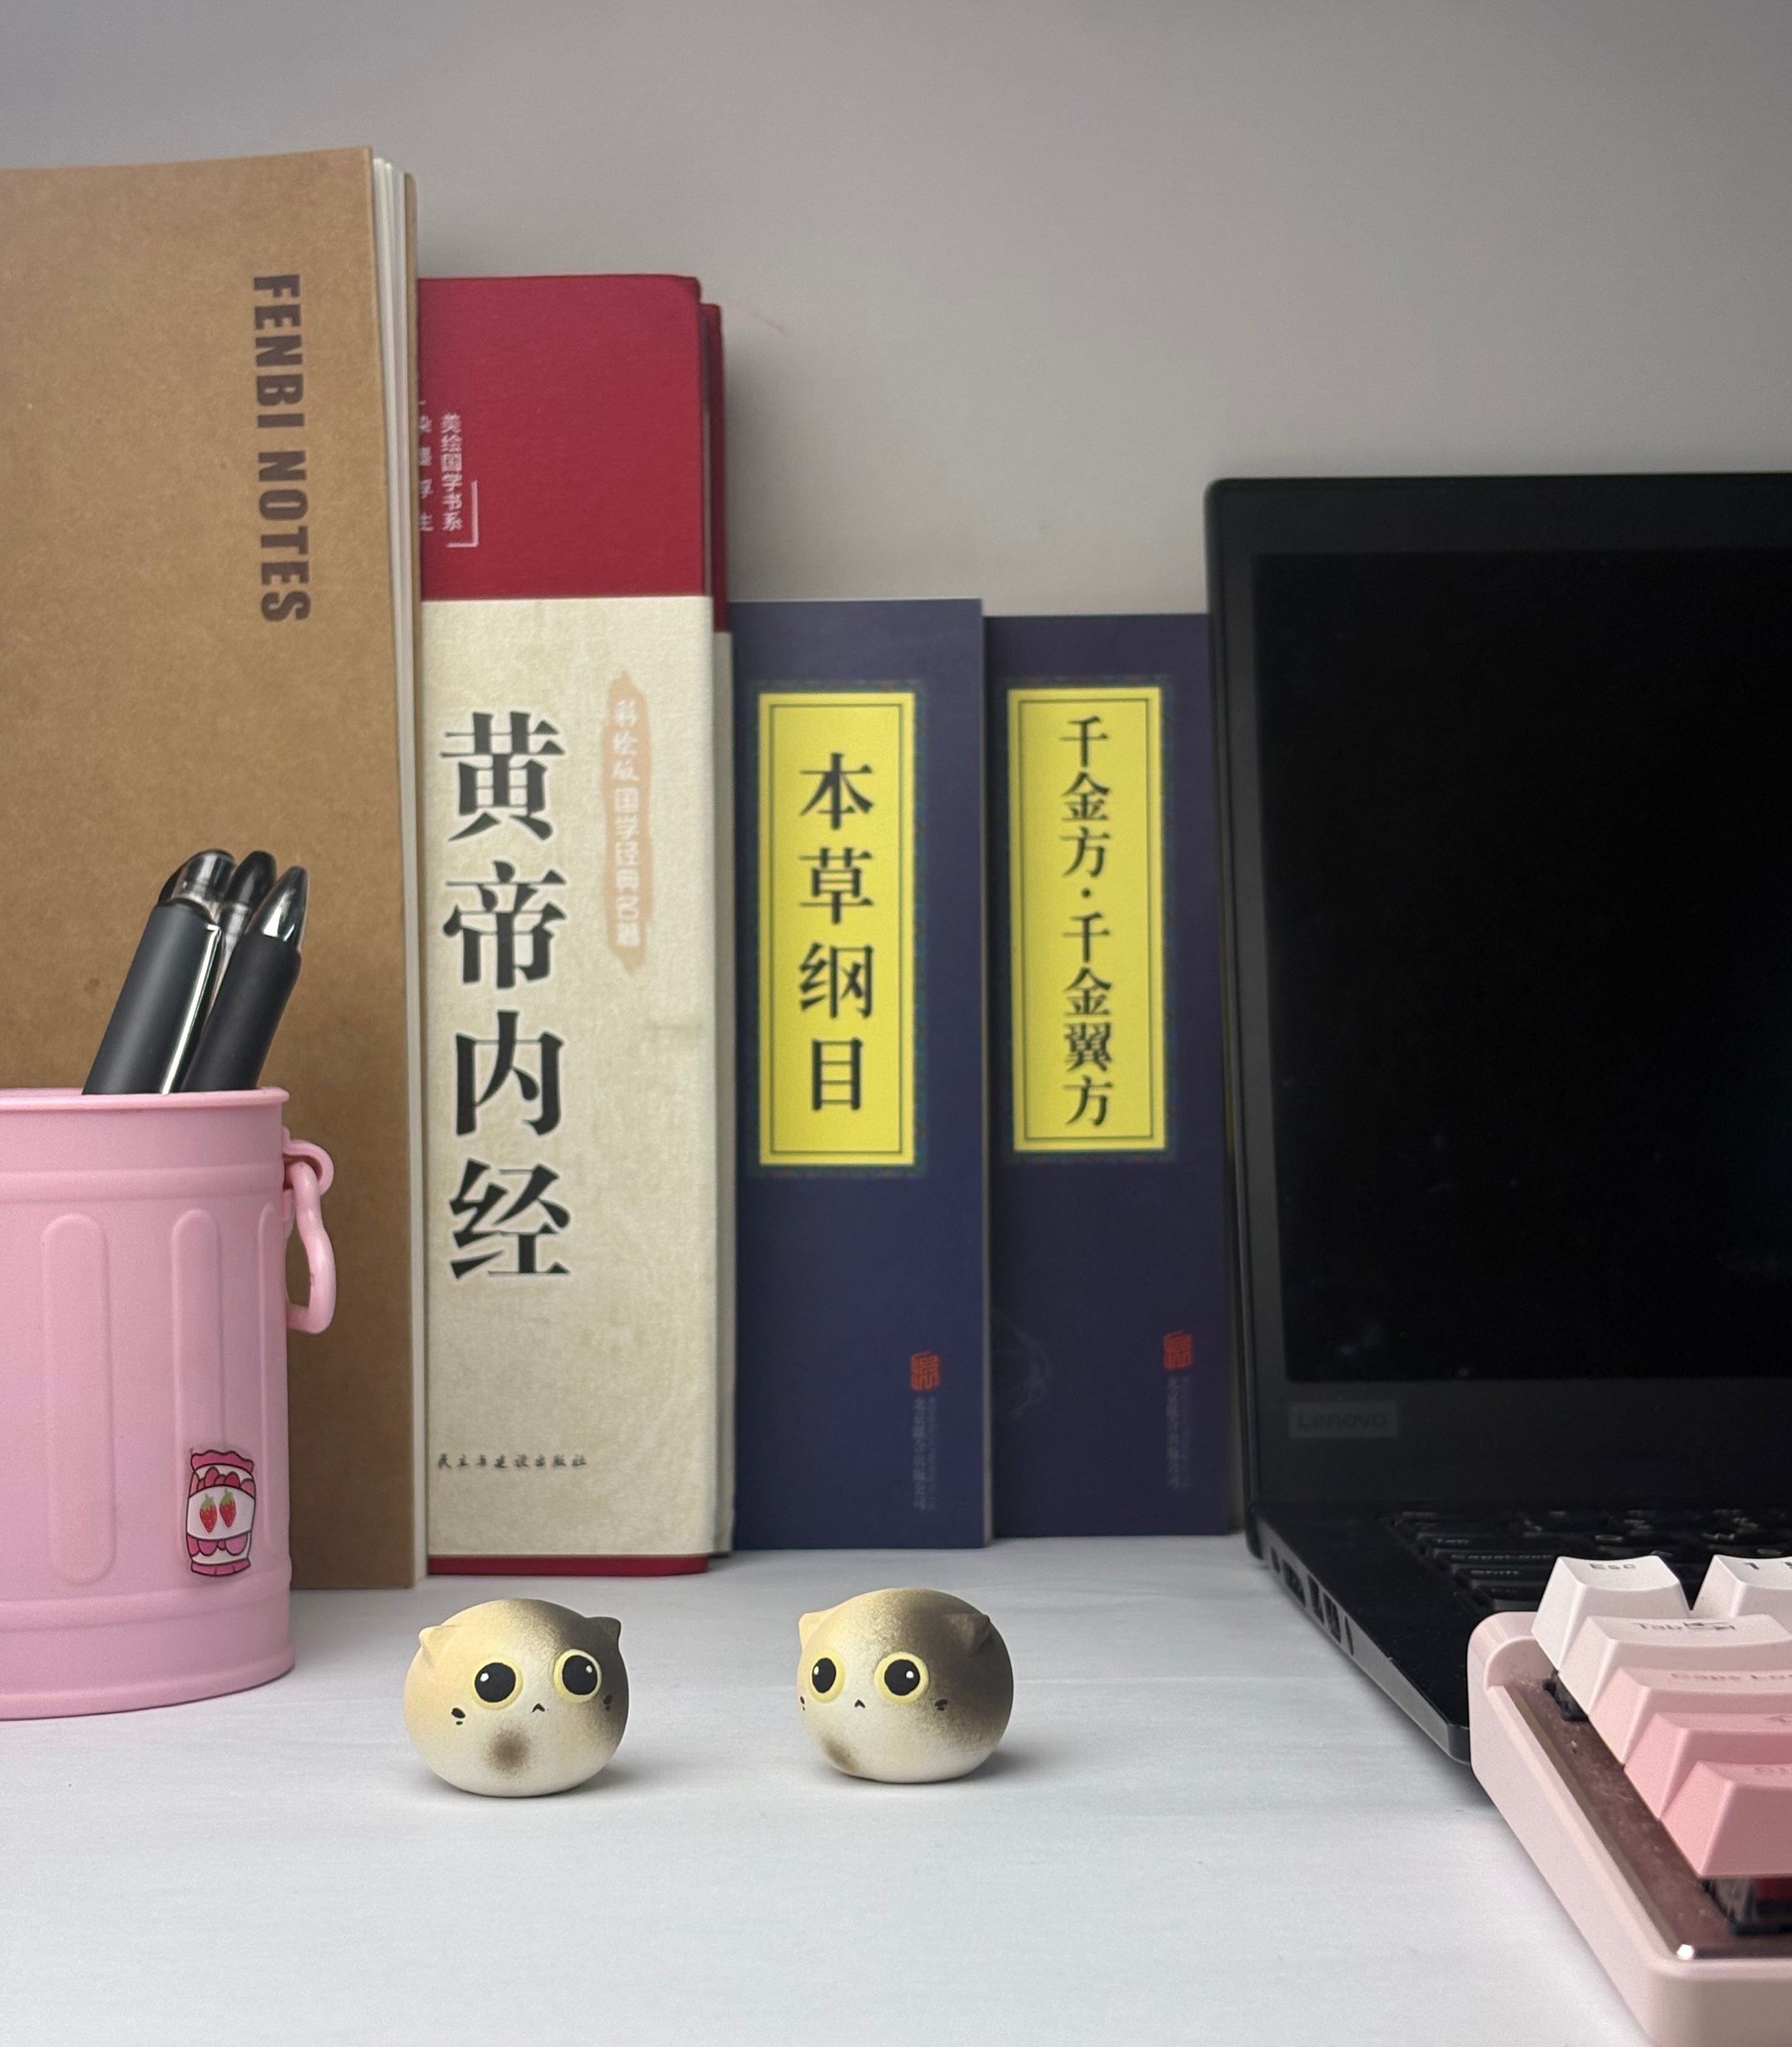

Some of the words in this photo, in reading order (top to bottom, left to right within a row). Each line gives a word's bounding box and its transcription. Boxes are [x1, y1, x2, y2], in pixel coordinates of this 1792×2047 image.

[254, 274, 305, 429] FENBI
[259, 450, 311, 622] NOTES
[440, 711, 570, 1279] 黄帝内经
[799, 752, 874, 1111] 本草纲目
[1060, 715, 1114, 1126] 千金方·千金翼方
[1297, 1409, 1388, 1429] Lenovo
